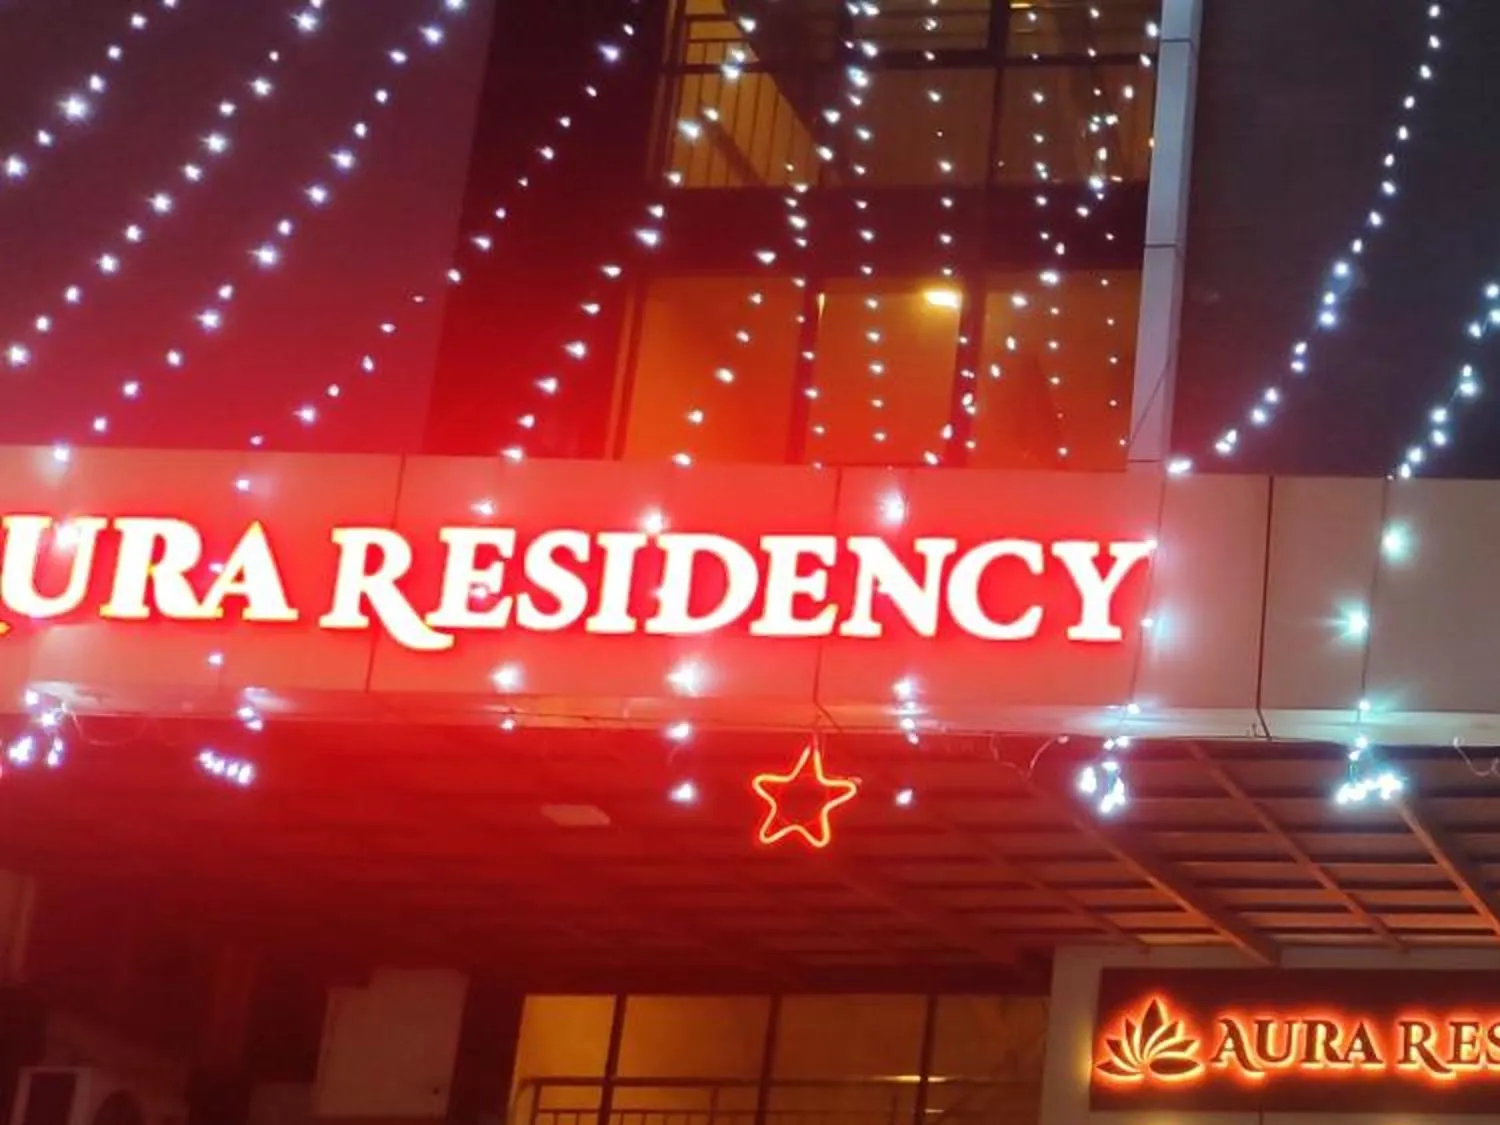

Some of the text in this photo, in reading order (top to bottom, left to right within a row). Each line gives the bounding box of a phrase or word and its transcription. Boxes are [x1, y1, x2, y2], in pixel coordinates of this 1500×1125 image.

[0, 515, 1152, 650] URA RESIDENCY
[1211, 1017, 1384, 1072] AURA
